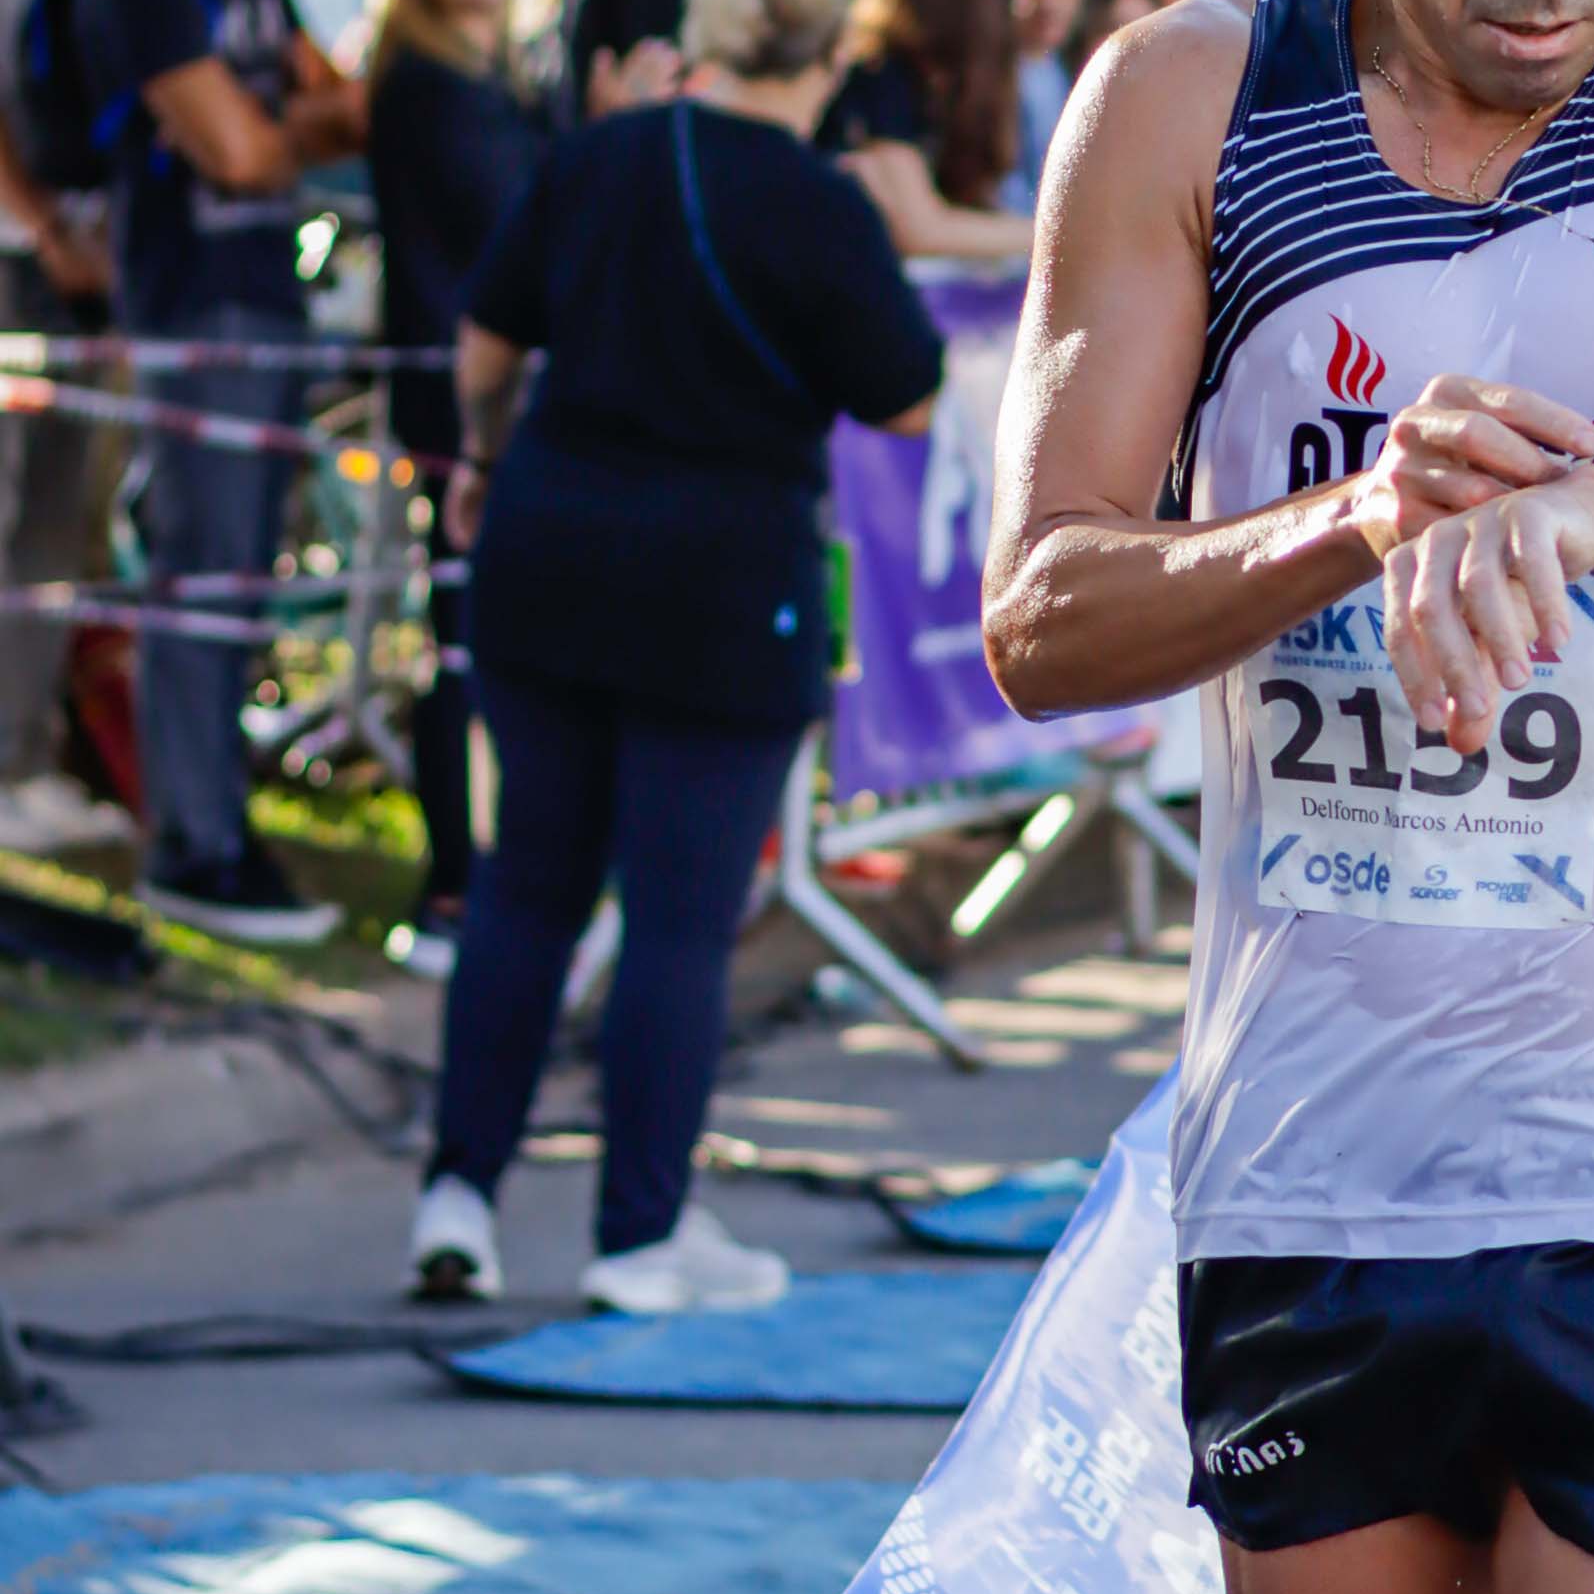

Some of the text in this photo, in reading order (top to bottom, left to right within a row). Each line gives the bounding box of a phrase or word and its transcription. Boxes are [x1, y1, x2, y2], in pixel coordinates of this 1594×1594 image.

[1259, 678, 1582, 801] 2159
[1301, 796, 1379, 824] Delforno
[1454, 812, 1544, 835] Antonio
[1304, 851, 1391, 895] osde
[1061, 1408, 1153, 1541] POWER
